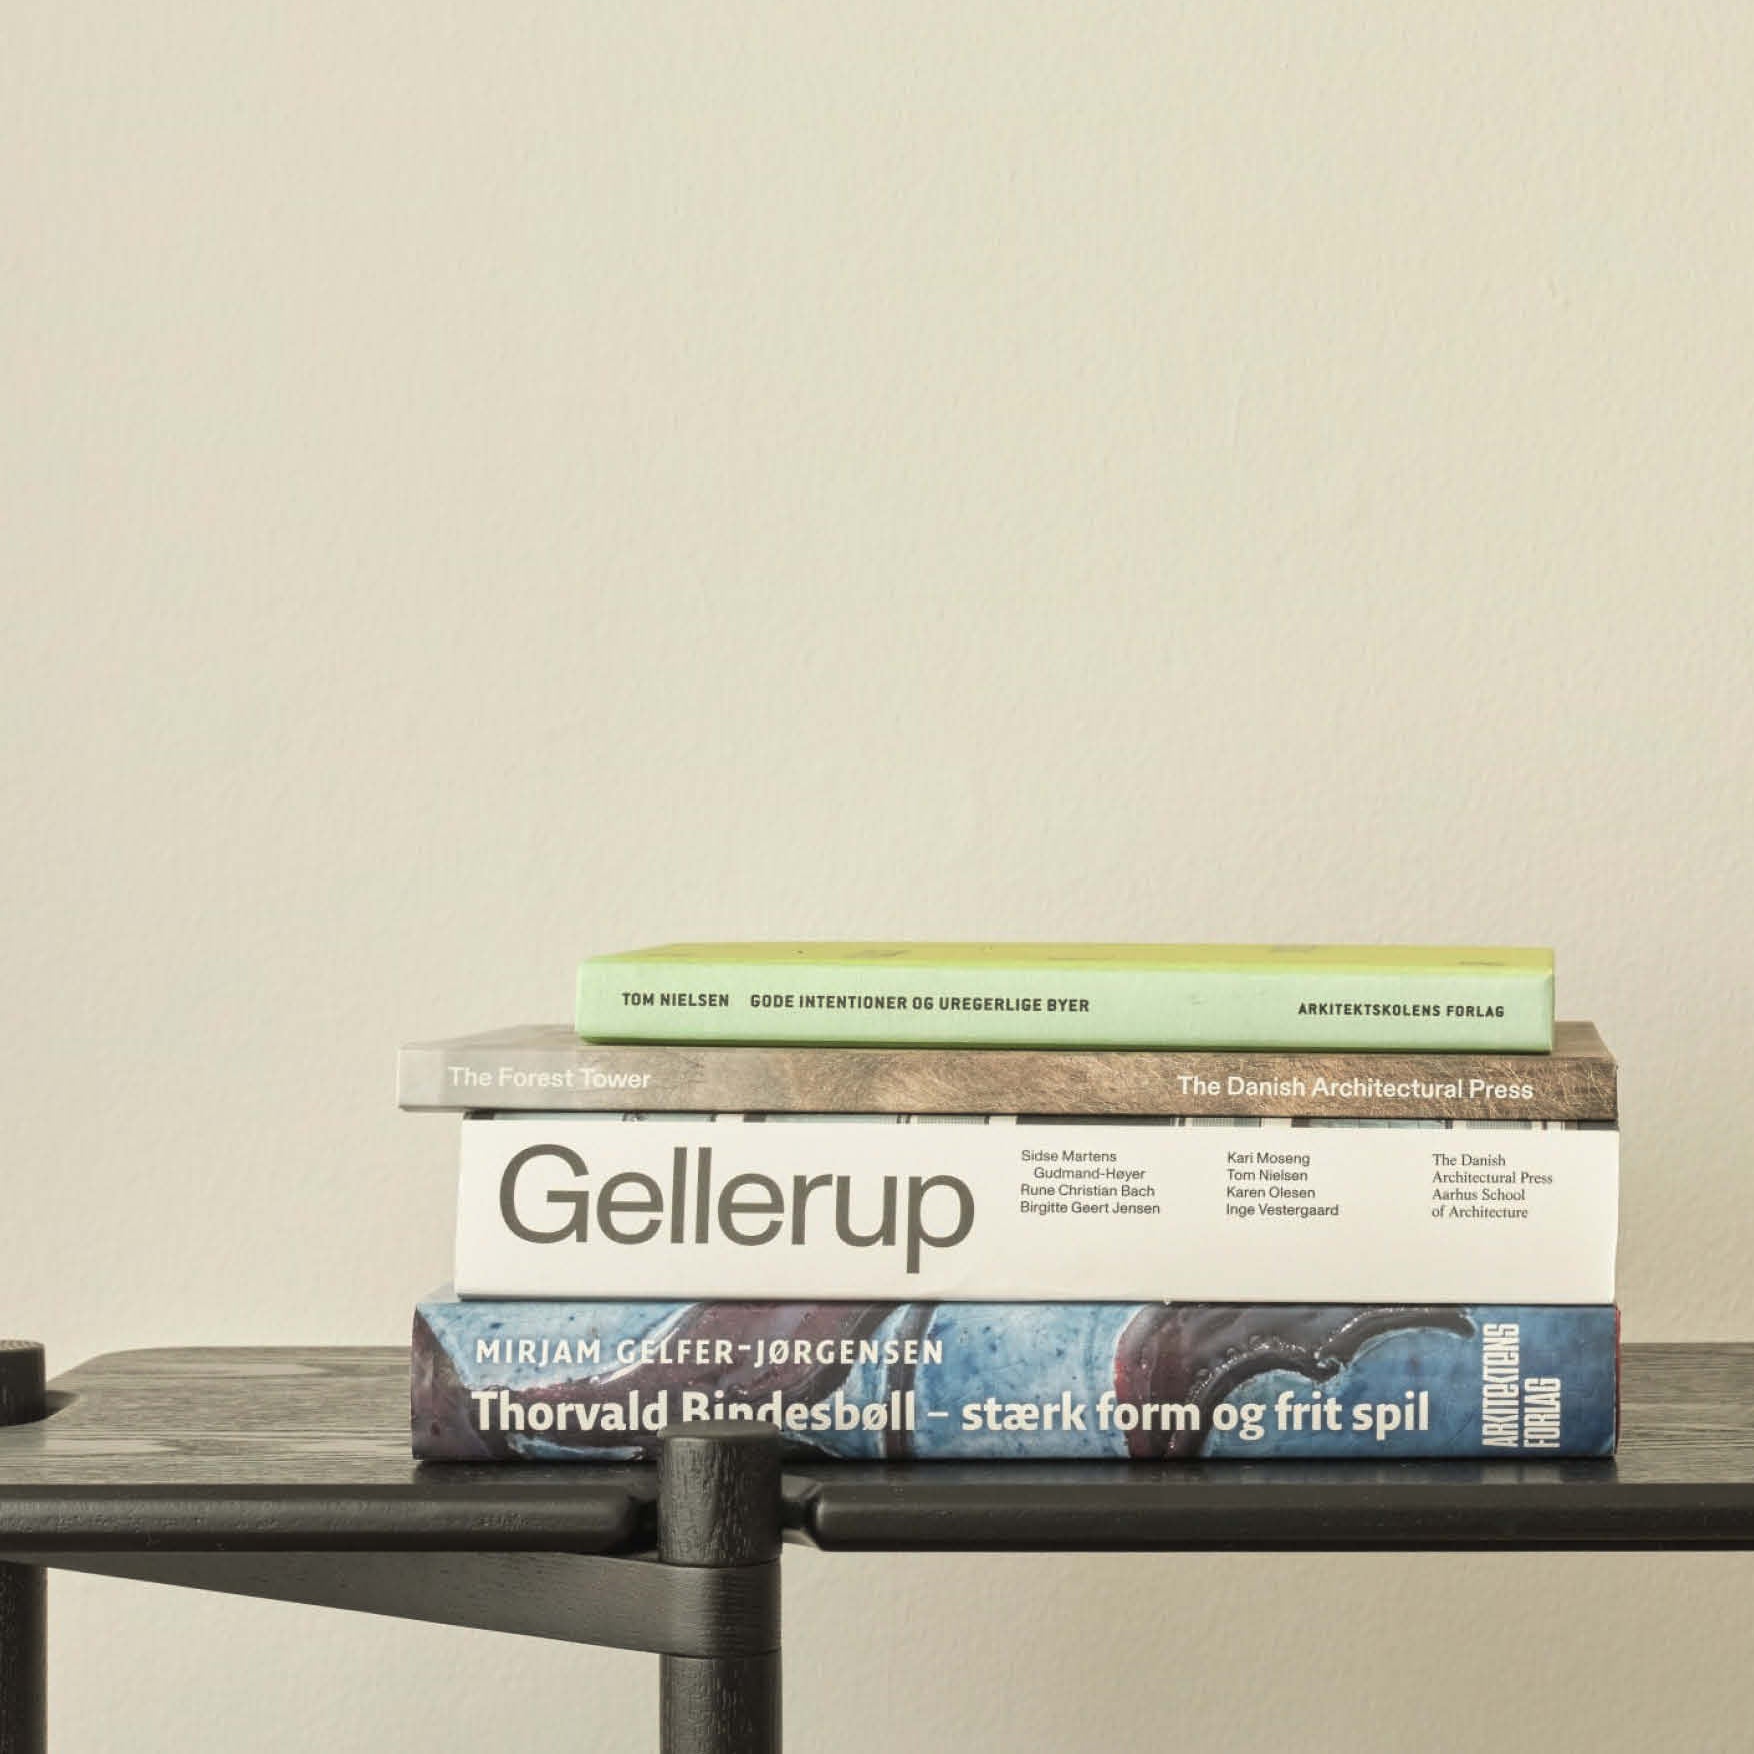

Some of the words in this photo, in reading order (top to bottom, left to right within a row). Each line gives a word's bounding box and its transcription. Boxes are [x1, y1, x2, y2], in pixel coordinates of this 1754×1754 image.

[622, 993, 654, 1006] TOM
[661, 993, 728, 1006] NIELSEN
[751, 995, 794, 1008] GODE
[800, 995, 907, 1009] INTENTIONER
[913, 997, 933, 1010] OG
[939, 997, 1041, 1011] UREGERLIGE
[1047, 999, 1089, 1012] BYER
[1298, 1003, 1440, 1016] ARKITEKTSKOLENS
[1446, 1006, 1504, 1017] FORLAG
[448, 1066, 491, 1088] The
[498, 1067, 574, 1089] Forest
[580, 1068, 651, 1089] Tower
[1178, 1076, 1221, 1096] The
[1228, 1076, 1305, 1098] Danish
[1312, 1078, 1464, 1099] Architectural
[1469, 1081, 1535, 1100] Press
[1022, 1150, 1058, 1161] Sidse
[1062, 1150, 1116, 1162] Martens
[1228, 1151, 1253, 1163] Kari
[1257, 1152, 1310, 1168] Moseng
[1432, 1154, 1456, 1166] The
[1462, 1154, 1505, 1166] Danish
[1034, 1167, 1146, 1182] Gudmand-Høyer
[1228, 1169, 1255, 1180] Tom
[1260, 1169, 1307, 1181] Nielsen
[1433, 1171, 1515, 1183] Architectural
[1521, 1172, 1552, 1184] Press
[1021, 1184, 1055, 1195] Rune
[1058, 1184, 1117, 1196] Christian
[1122, 1185, 1155, 1196] Bach
[1227, 1186, 1265, 1198] Karen
[1269, 1186, 1315, 1198] Olesen
[1433, 1188, 1478, 1200] Aarhus
[1482, 1188, 1525, 1200] School
[500, 1144, 974, 1274] Gellerup
[1021, 1201, 1067, 1215] Birgitte
[1072, 1202, 1109, 1214] Geert
[1112, 1202, 1160, 1214] Jensen
[1227, 1203, 1255, 1218] Inge
[1258, 1204, 1339, 1218] Vestergaard
[1432, 1205, 1445, 1217] of
[1449, 1206, 1528, 1218] Architecture
[475, 1340, 601, 1366] MIRJAM
[616, 1340, 943, 1367] GELFER-JØRGENSEN
[471, 1390, 667, 1431] Thorvald
[962, 1391, 1087, 1433] stærk
[1097, 1389, 1199, 1431] form
[1214, 1398, 1266, 1441] og
[1274, 1389, 1342, 1431] frit
[1352, 1390, 1430, 1441] spil
[1523, 1377, 1561, 1448] FORLAG
